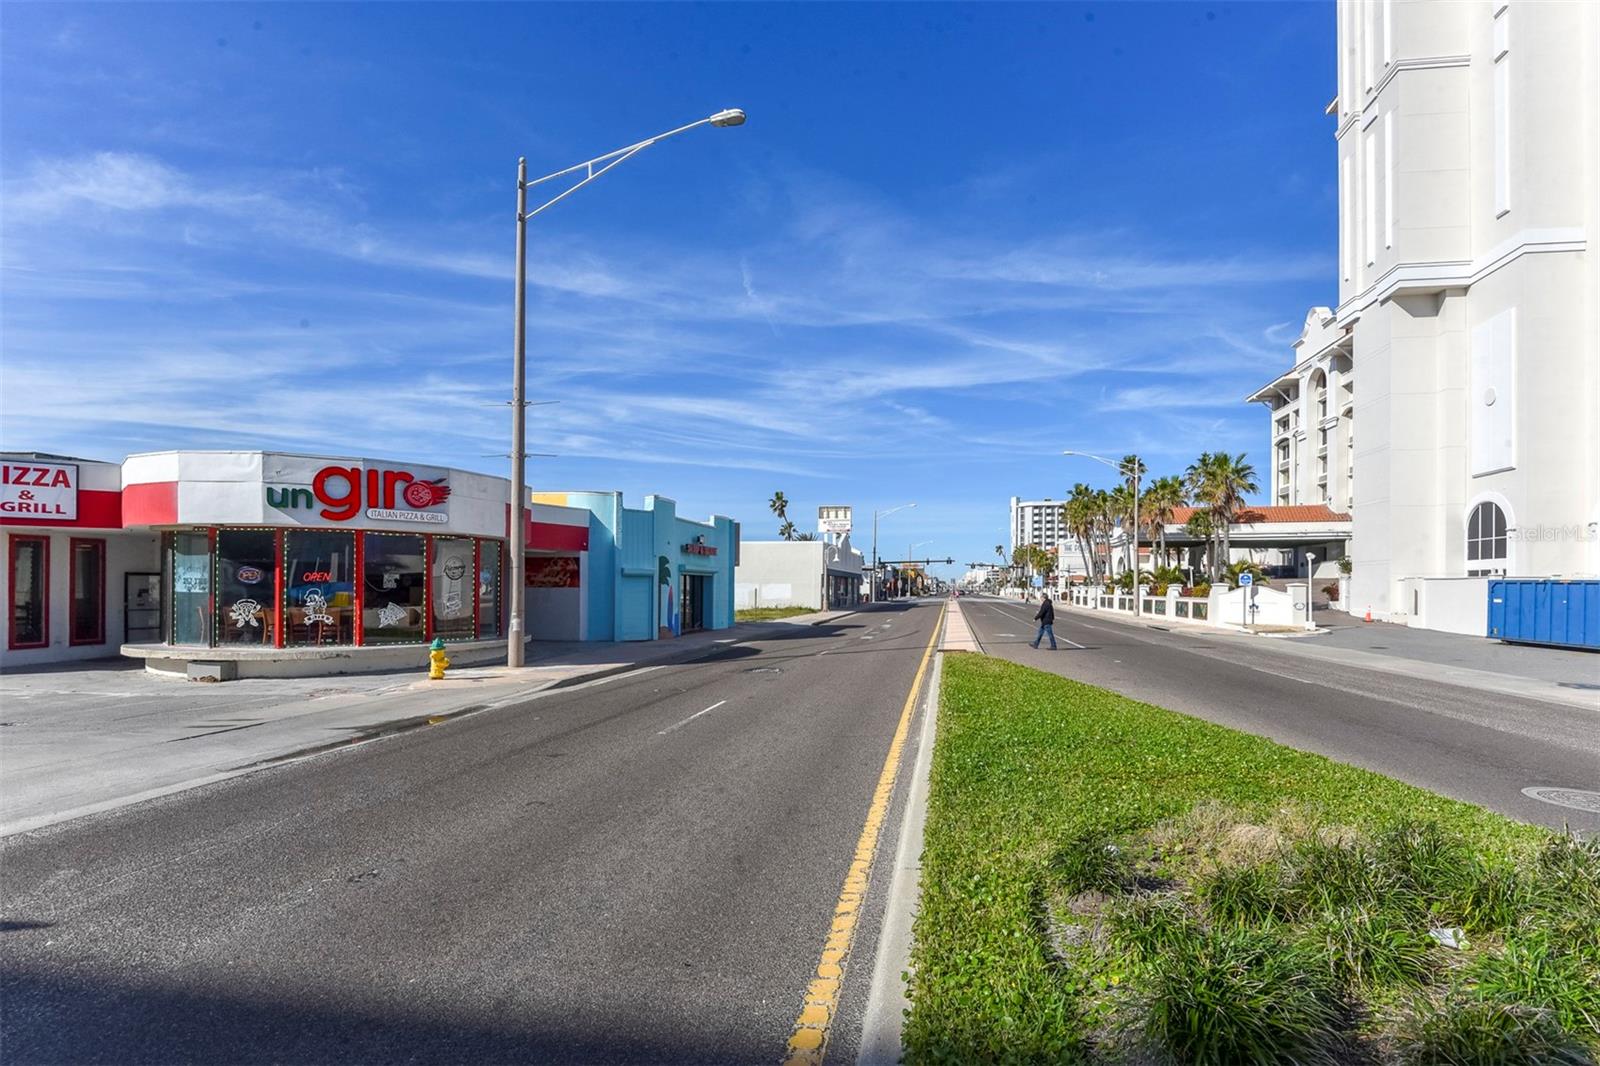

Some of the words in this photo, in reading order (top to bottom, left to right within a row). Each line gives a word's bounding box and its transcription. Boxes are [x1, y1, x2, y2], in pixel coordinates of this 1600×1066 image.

[18, 489, 35, 501] &
[266, 486, 313, 509] un
[0, 501, 67, 515] GRILL
[371, 510, 398, 519] ITALIAN
[399, 511, 419, 520] PIZZA
[426, 512, 444, 522] GRILL
[303, 572, 332, 581] OPEN
